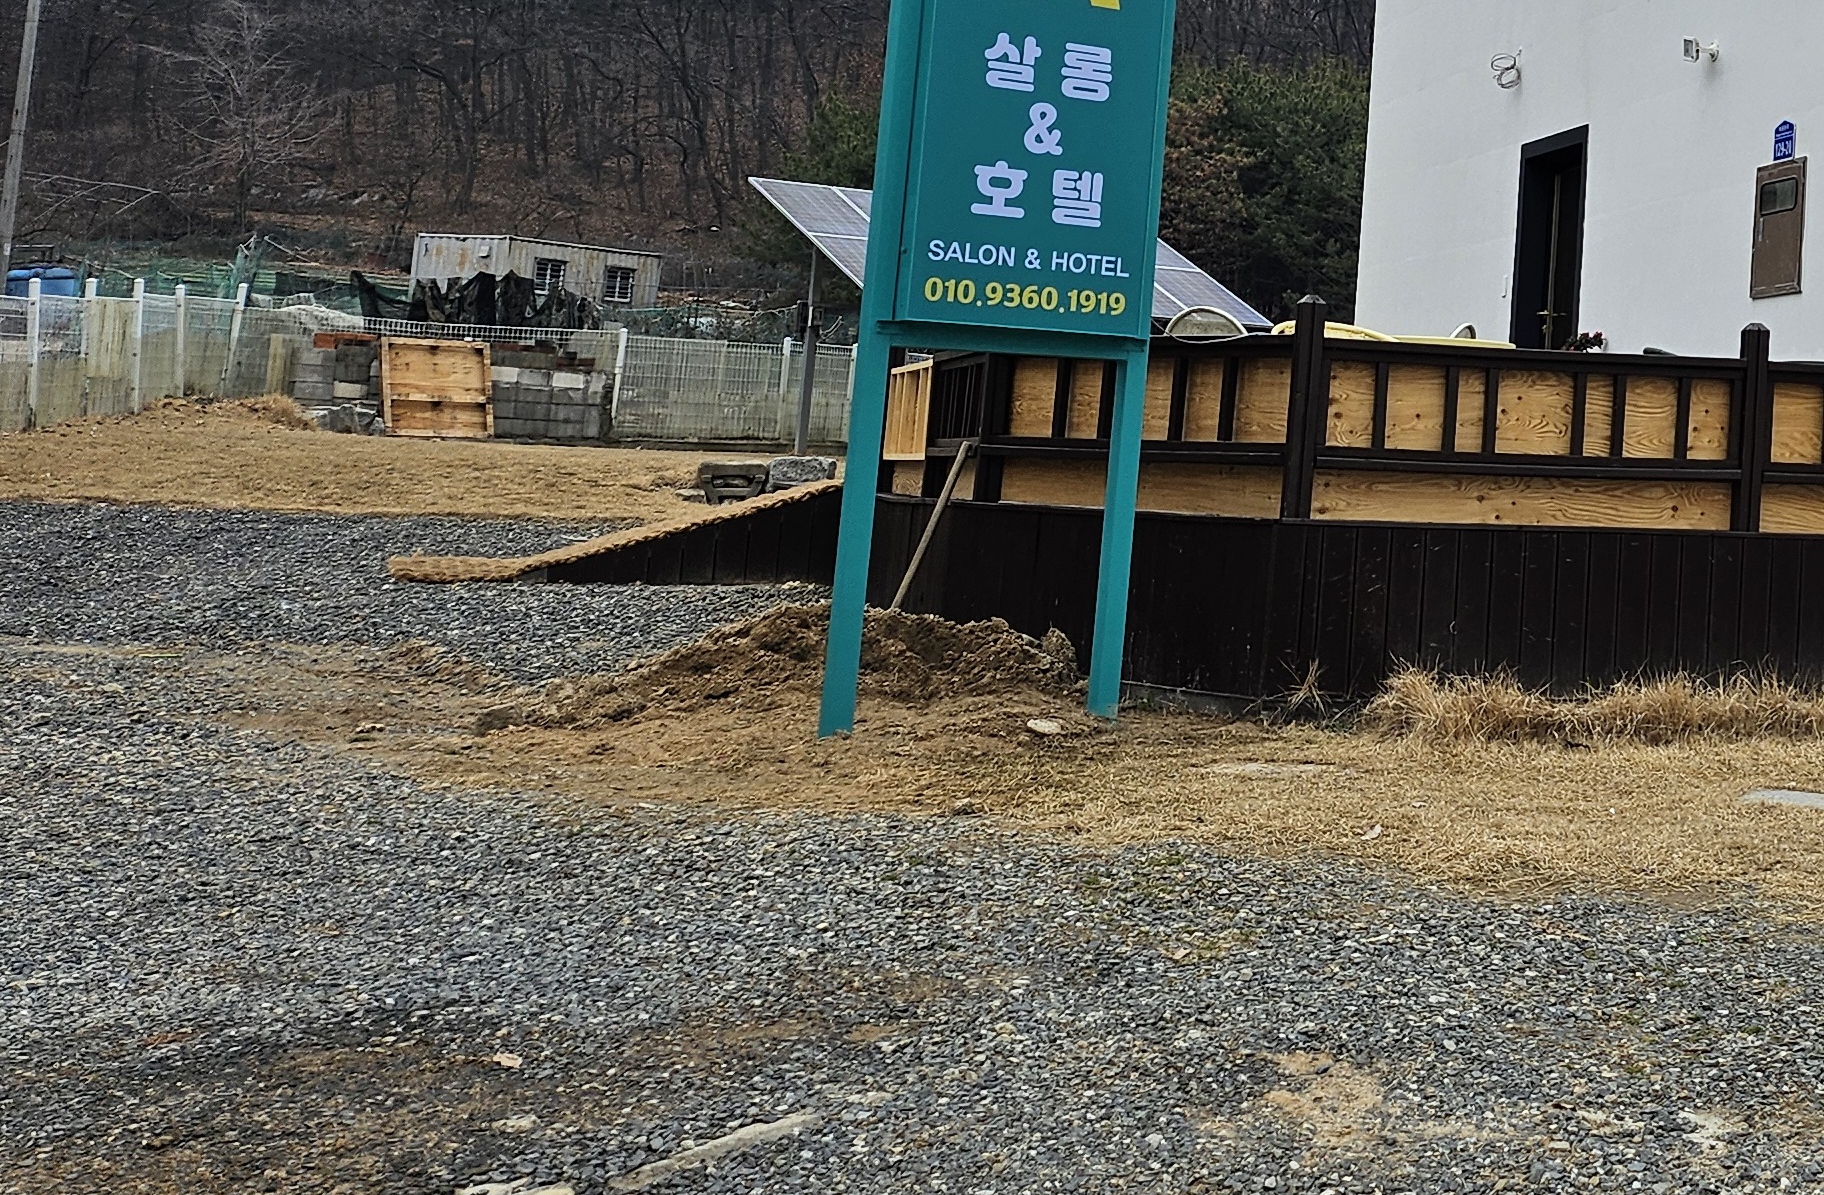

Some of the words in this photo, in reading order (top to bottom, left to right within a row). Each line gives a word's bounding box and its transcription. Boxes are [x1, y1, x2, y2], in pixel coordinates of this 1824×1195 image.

[984, 32, 1113, 102] 살롱
[1023, 102, 1063, 156] &
[970, 160, 1104, 228] 호텔
[927, 239, 1016, 267] SALON
[1024, 248, 1042, 270] &
[1051, 250, 1130, 278] HOTEL
[924, 277, 1126, 316] 010.9360.1919
